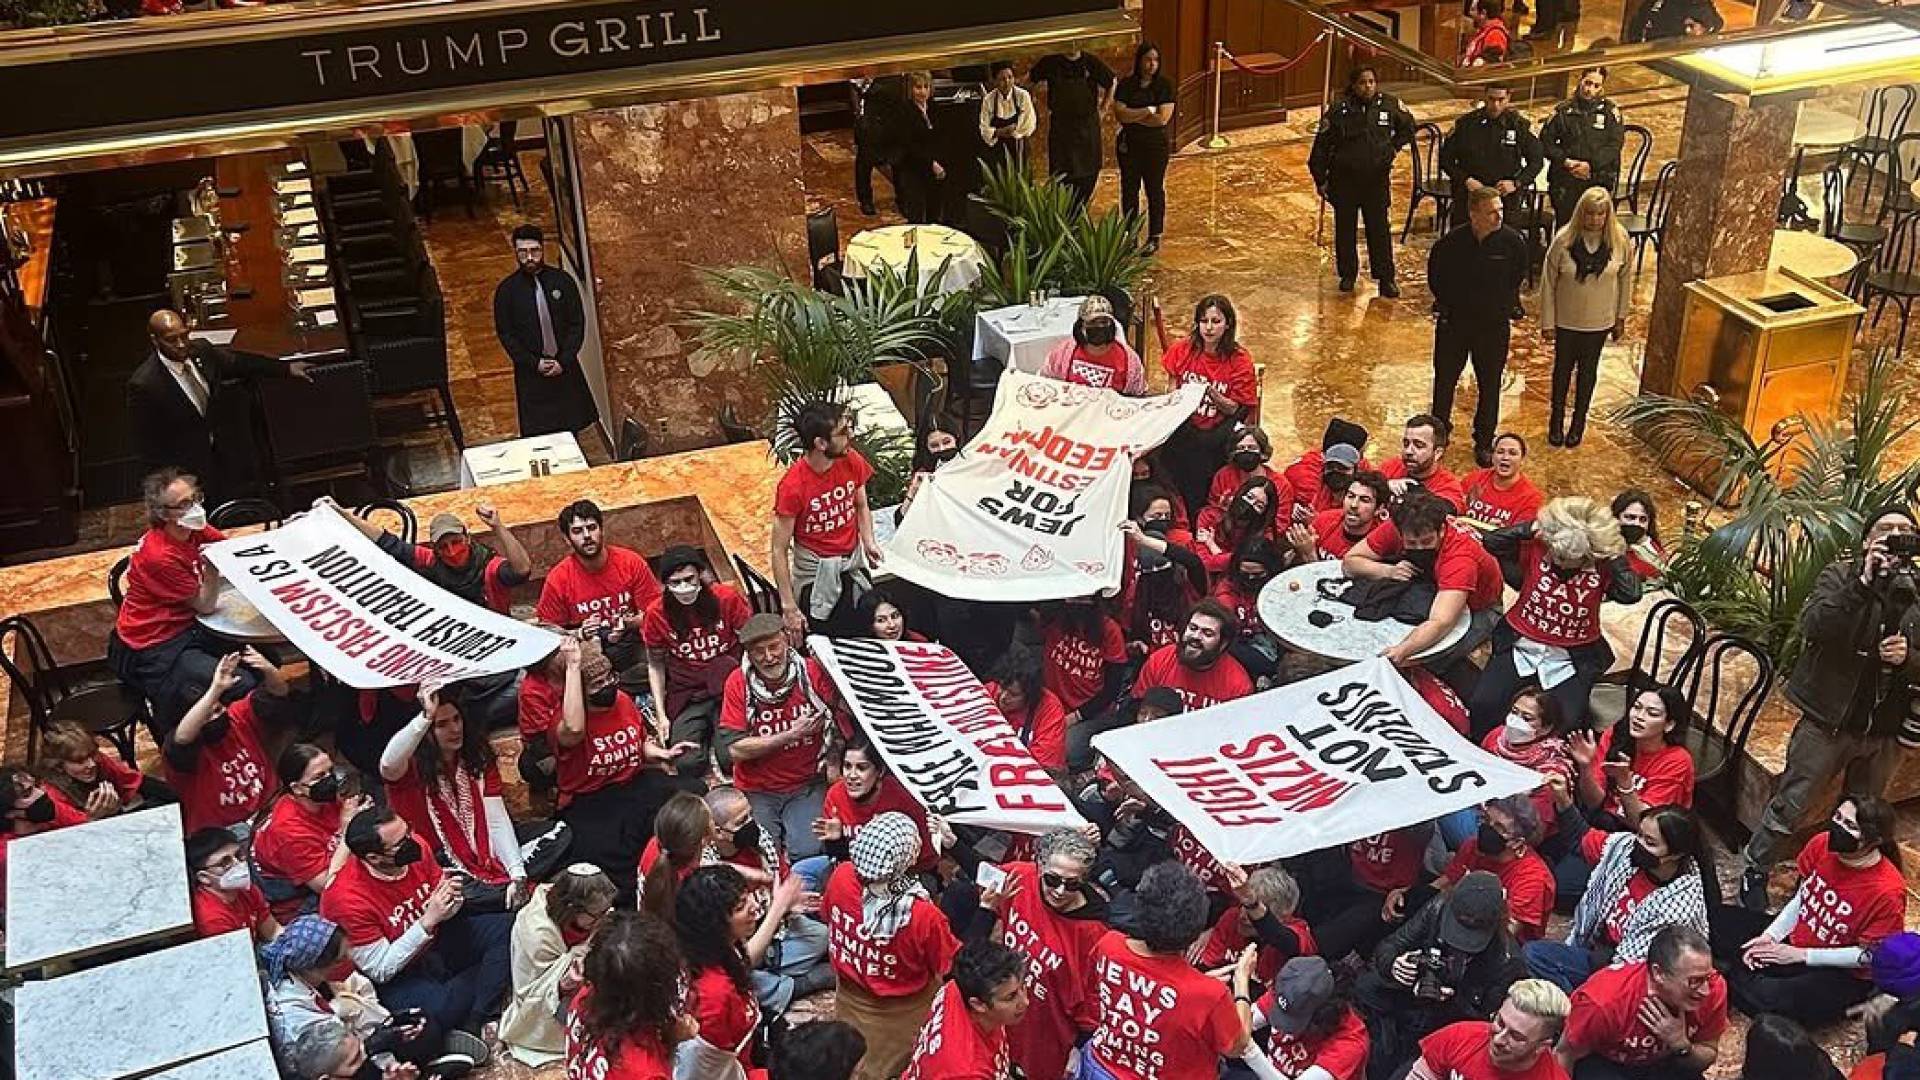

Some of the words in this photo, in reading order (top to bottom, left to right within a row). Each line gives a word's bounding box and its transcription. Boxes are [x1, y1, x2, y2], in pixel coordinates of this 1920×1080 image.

[302, 29, 529, 86] TRUMP
[549, 8, 721, 57] GRILL
[806, 498, 854, 522] ARMIN
[810, 481, 855, 512] STOP
[977, 497, 1086, 537] JEWS
[1005, 479, 1081, 516] FOR
[232, 543, 276, 558] A
[249, 559, 297, 583] IS
[302, 544, 435, 633] TRADITION
[577, 596, 612, 614] NOT
[1530, 590, 1589, 618] STOP
[1538, 576, 1590, 603] SAY
[270, 580, 389, 658] FASCISM
[412, 613, 517, 663] JEWISH
[679, 634, 719, 655] OUR
[756, 708, 784, 723] OT
[591, 740, 641, 765] ARMIN
[592, 725, 637, 752] STOP
[1286, 724, 1408, 783] NOT
[1317, 682, 1487, 794] STUDENTS
[1150, 757, 1282, 827] FIGHT
[1219, 733, 1358, 813] NAZIS
[831, 904, 891, 948] STO
[1800, 886, 1849, 935] RMING
[1800, 904, 1841, 945] RAEL
[829, 923, 898, 966] RMING
[1096, 954, 1178, 1010] JEWS
[1099, 980, 1163, 1026] SAY
[1092, 1024, 1164, 1068] RMING
[1100, 1044, 1159, 1080] RAEL
